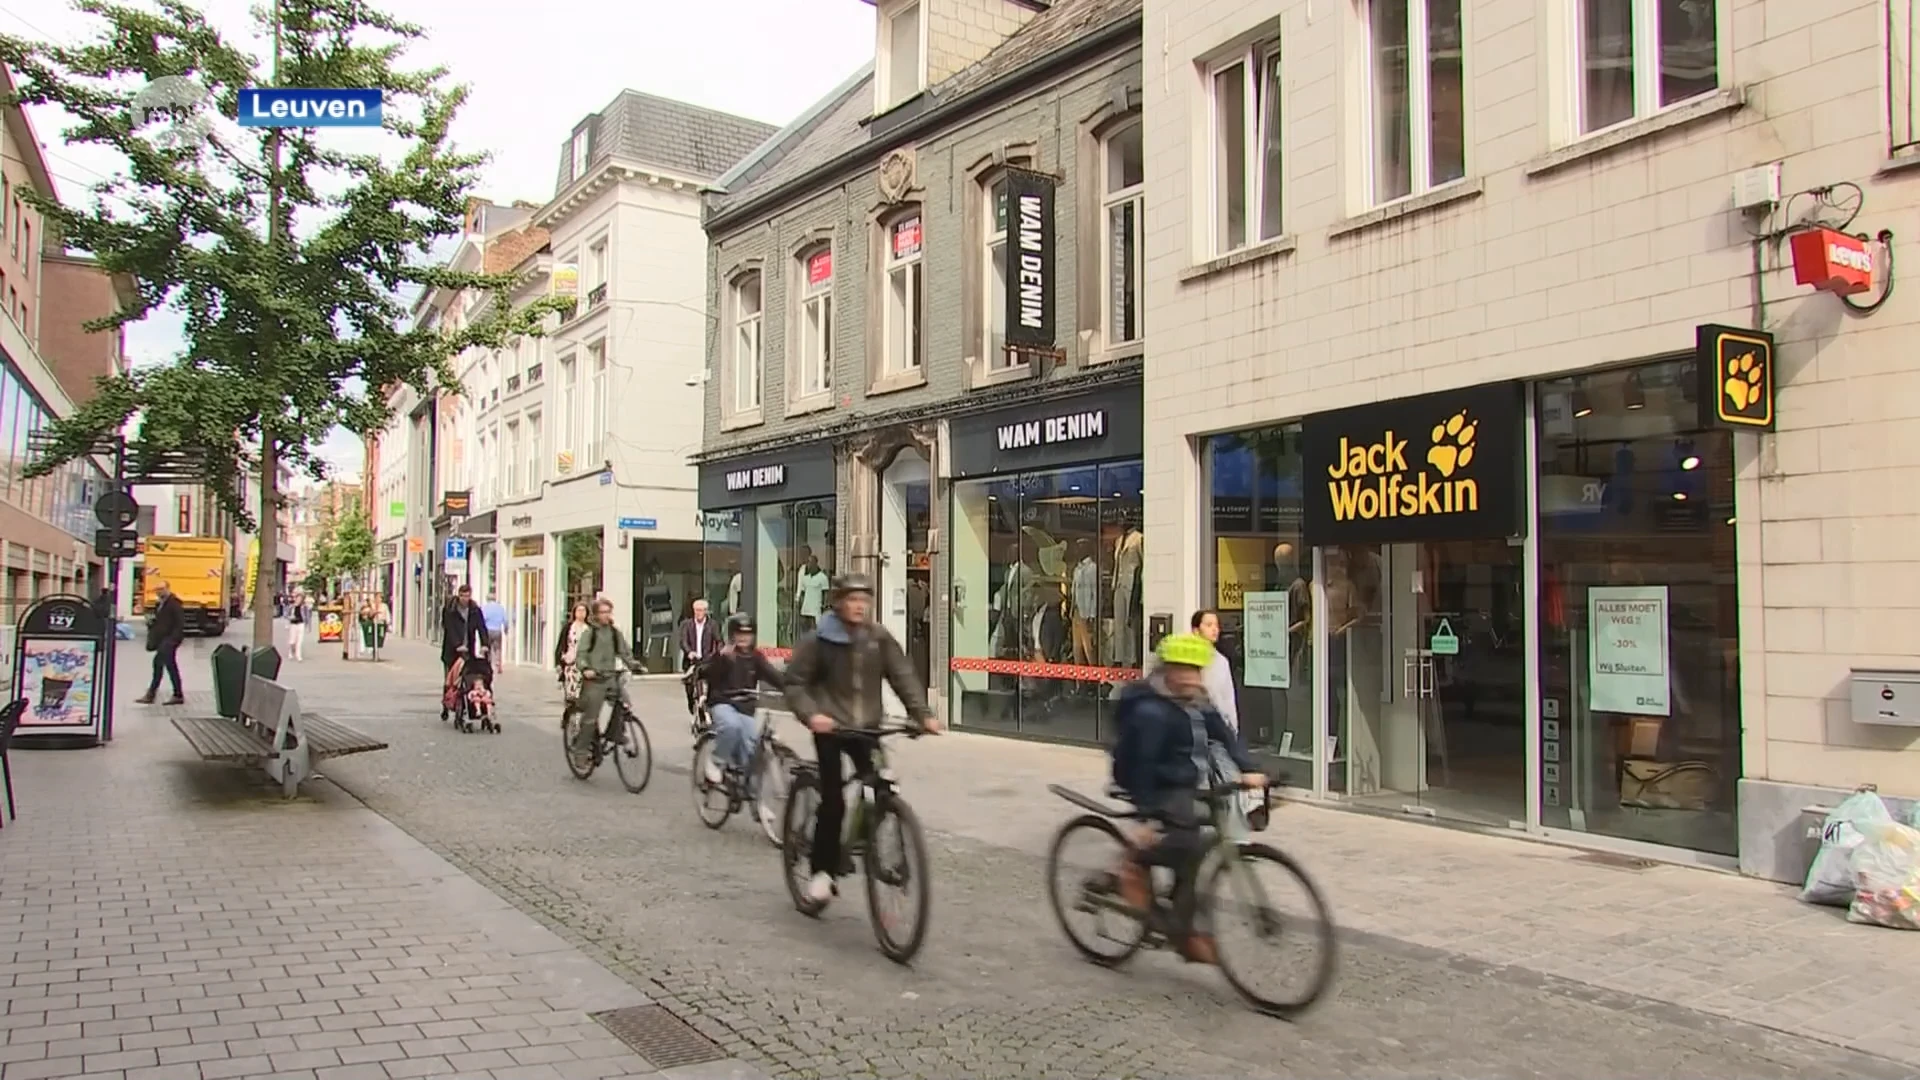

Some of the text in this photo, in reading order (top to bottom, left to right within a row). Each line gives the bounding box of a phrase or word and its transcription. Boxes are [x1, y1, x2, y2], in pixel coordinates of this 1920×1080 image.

[1020, 196, 1042, 328] WAM DENIM
[998, 410, 1103, 450] WAM DENIM
[1328, 430, 1408, 479] Jack
[726, 464, 784, 491] WAM DENIM
[1328, 471, 1478, 521] Wolfskin
[49, 614, 75, 628] izy
[1599, 604, 1657, 613] ALLES MOET
[1611, 616, 1634, 624] WEG
[1612, 640, 1637, 649] -30%
